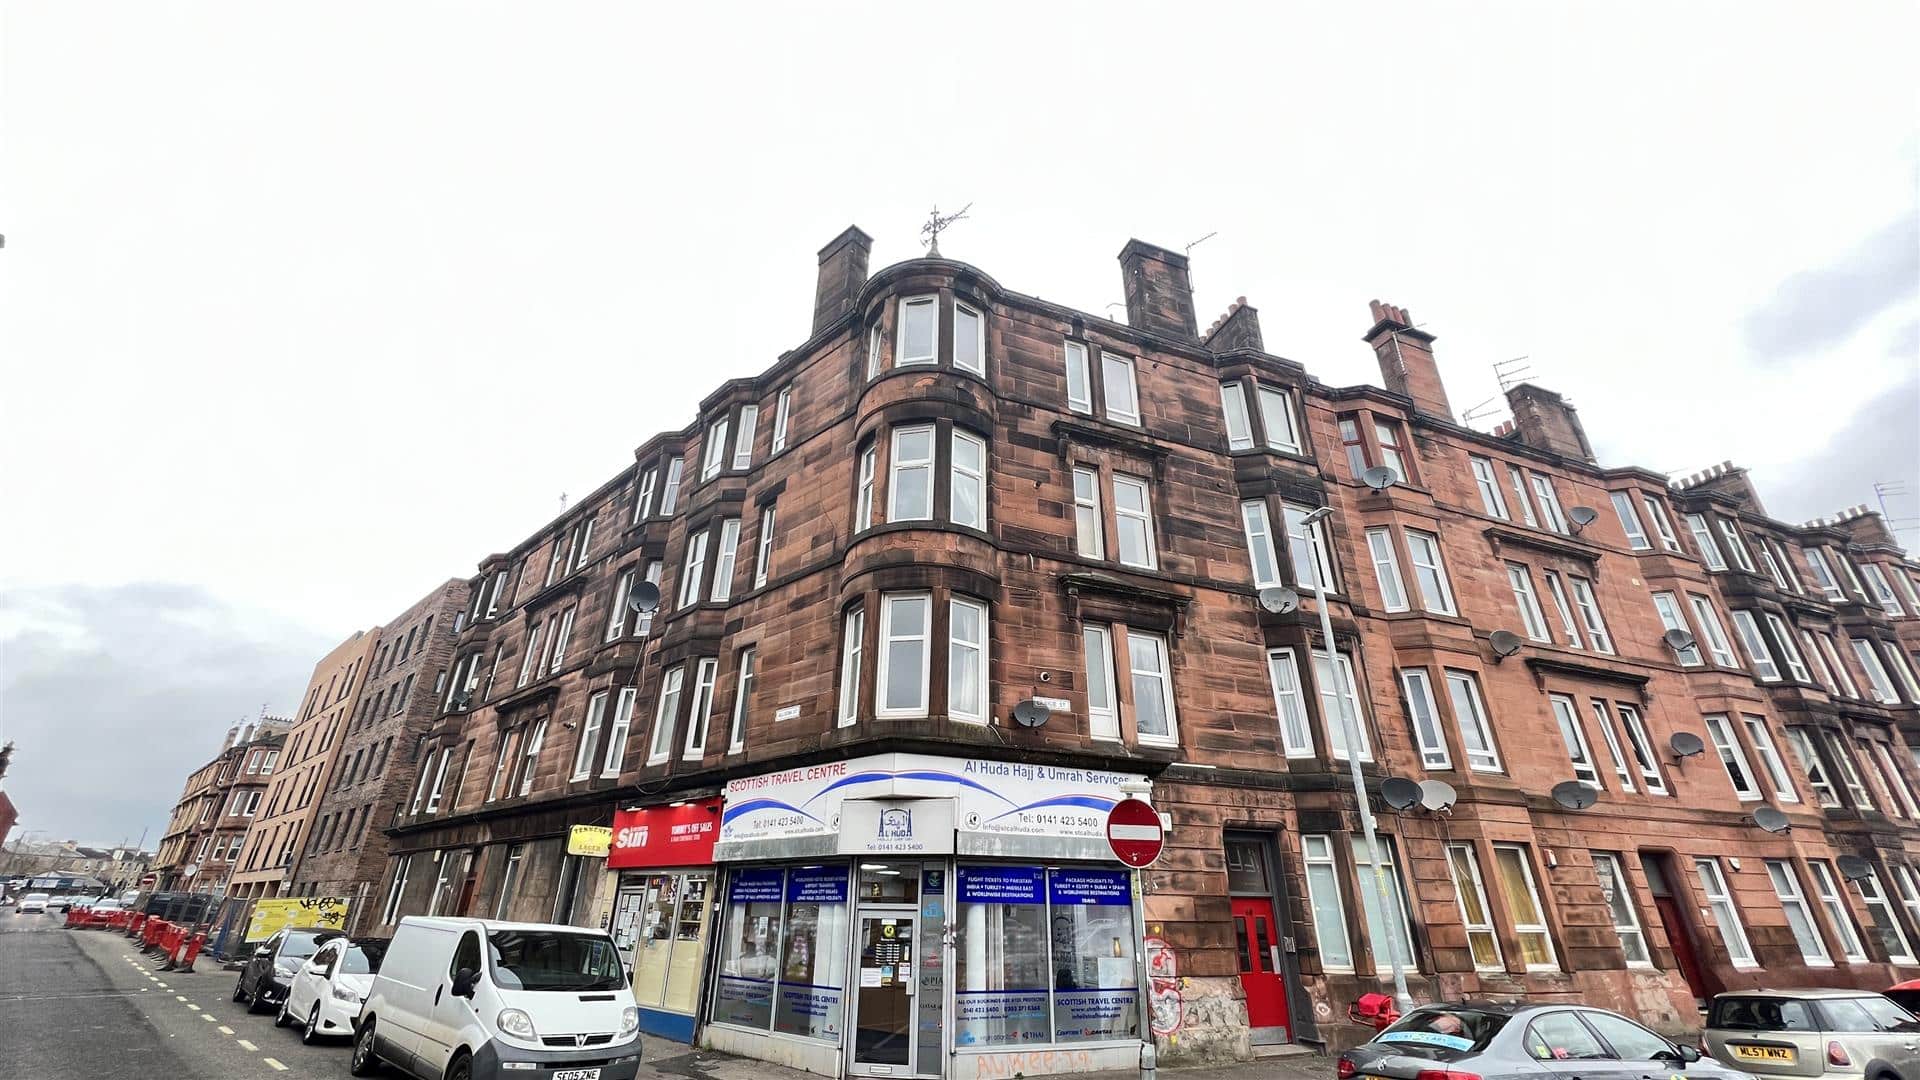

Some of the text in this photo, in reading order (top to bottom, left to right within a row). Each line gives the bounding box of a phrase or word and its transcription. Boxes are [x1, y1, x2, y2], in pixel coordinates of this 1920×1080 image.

[729, 762, 847, 793] SCOTTISH TRAVEL CENTRE
[964, 760, 1129, 785] Al Huda Hajj & Umrah Services
[763, 818, 777, 828] 0141
[777, 816, 789, 826] 423
[789, 815, 804, 825] 5400
[1018, 812, 1098, 828] Tel: 0141 423 5400
[700, 821, 713, 832] SALES
[616, 827, 648, 848] Sun
[821, 995, 838, 1004] CENTRE
[1056, 997, 1133, 1006] SCOTTISH TRAVEL CENTRE
[1768, 1047, 1788, 1059] WNZ
[556, 1070, 597, 1080] SE05 ZNE
